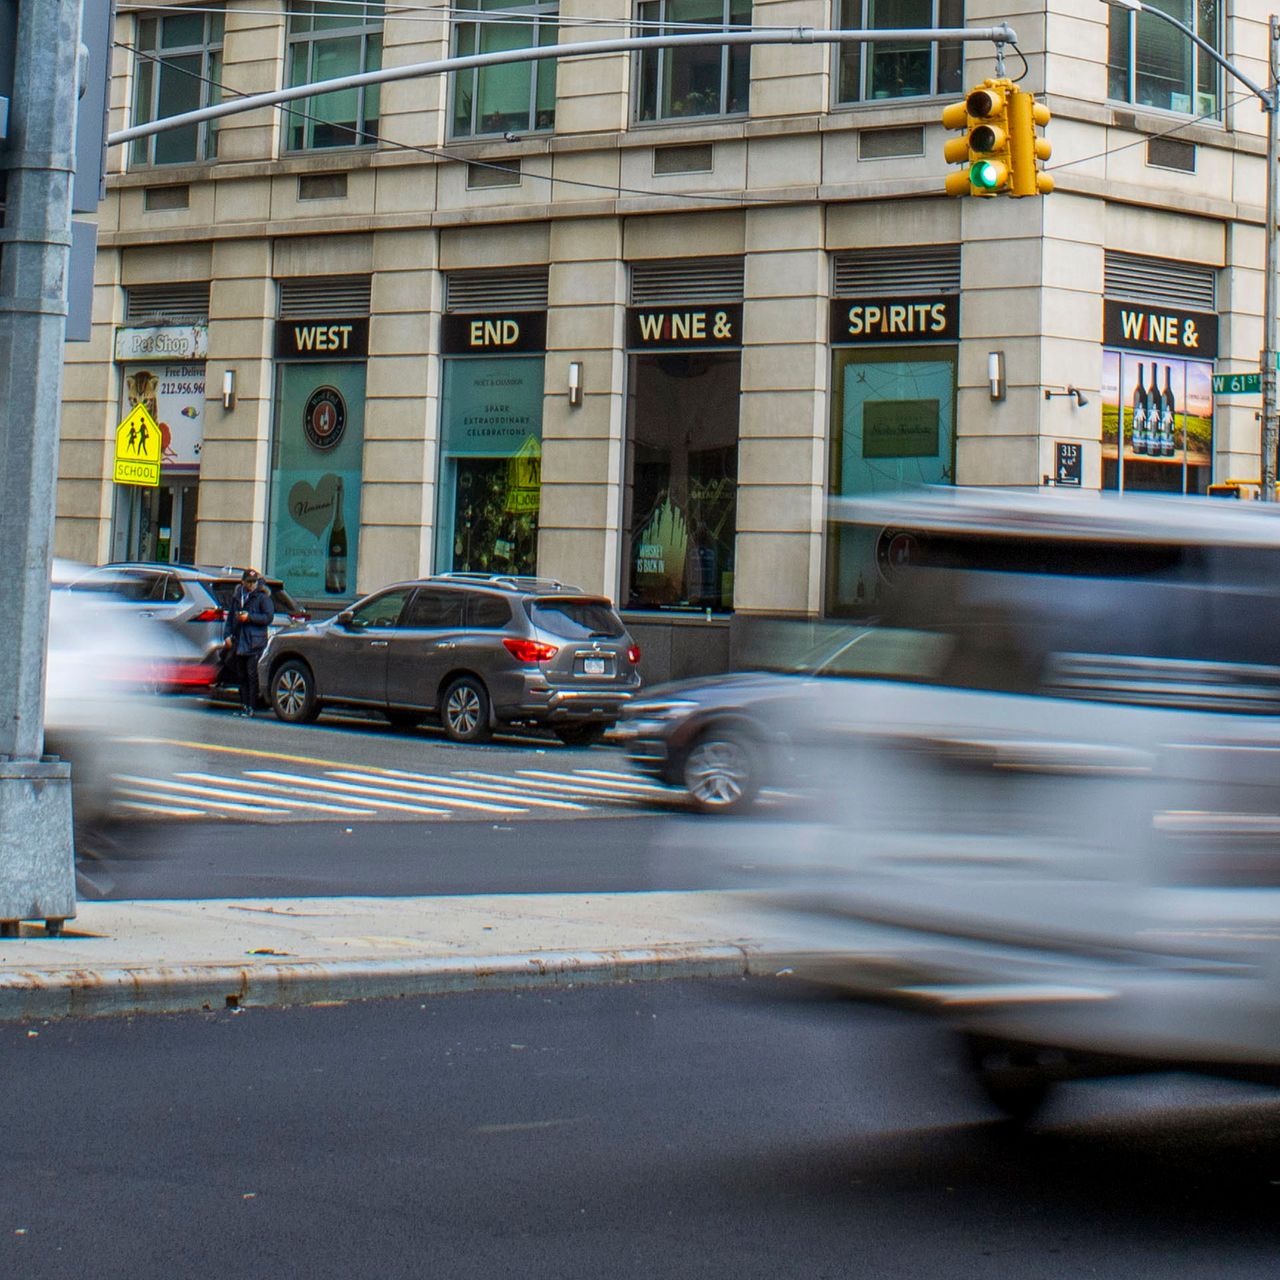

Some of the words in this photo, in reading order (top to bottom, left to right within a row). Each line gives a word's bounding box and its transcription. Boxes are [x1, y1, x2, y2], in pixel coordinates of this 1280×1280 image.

[639, 313, 707, 340] WINE
[713, 311, 732, 338] &
[848, 303, 946, 334] SPIRITS
[1121, 310, 1178, 345] WINE
[1183, 319, 1198, 348] &
[295, 326, 352, 350] WEST
[471, 320, 519, 345] END
[132, 335, 154, 353] Pet
[156, 334, 189, 355] Shop
[165, 366, 181, 377] Free
[1213, 376, 1224, 391] W
[1231, 376, 1245, 391] 61
[1248, 375, 1258, 384] ST
[1061, 444, 1077, 457] 315
[117, 464, 156, 479] SCHOOL
